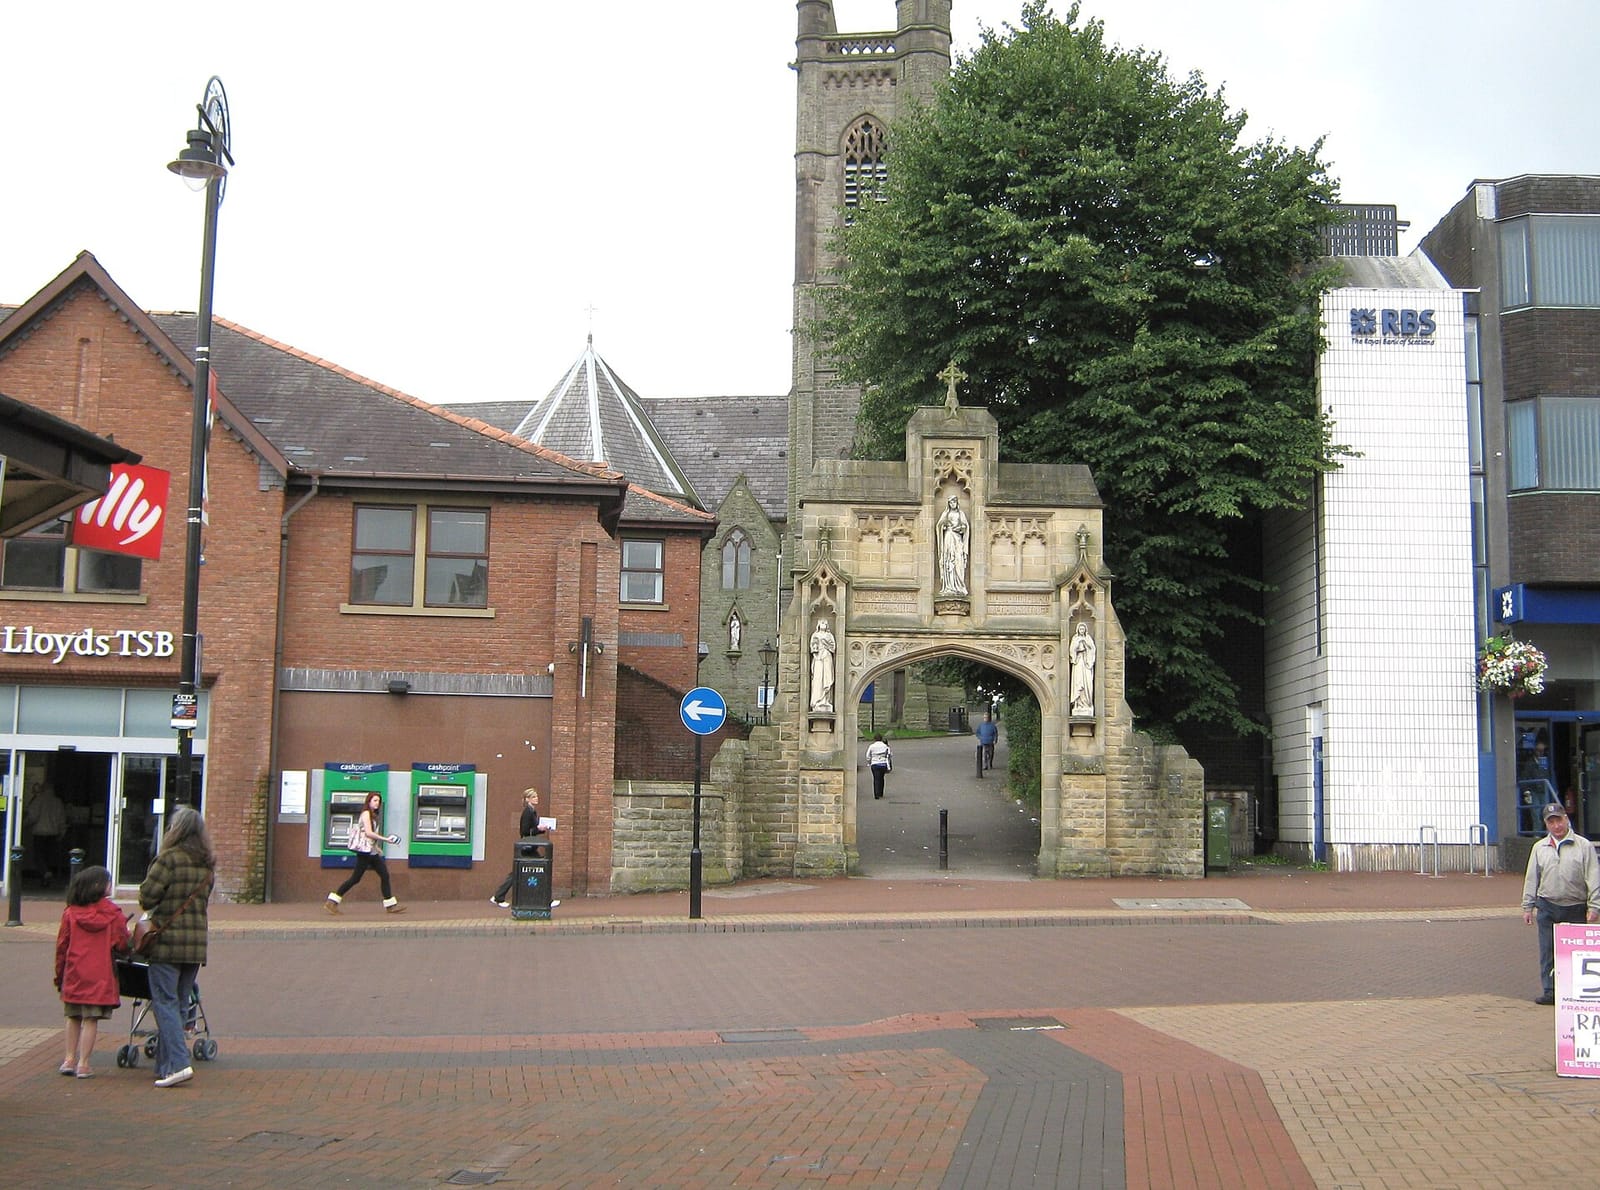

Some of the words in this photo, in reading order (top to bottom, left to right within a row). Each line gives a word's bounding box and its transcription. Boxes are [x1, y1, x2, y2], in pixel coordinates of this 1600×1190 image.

[1381, 309, 1436, 336] RBS
[1364, 338, 1381, 346] Royal
[1408, 338, 1435, 346] Scotland
[3, 625, 111, 664] Lloyds
[116, 630, 175, 657] TSB
[340, 763, 372, 771] cashpoint
[1577, 1047, 1590, 1058] IN
